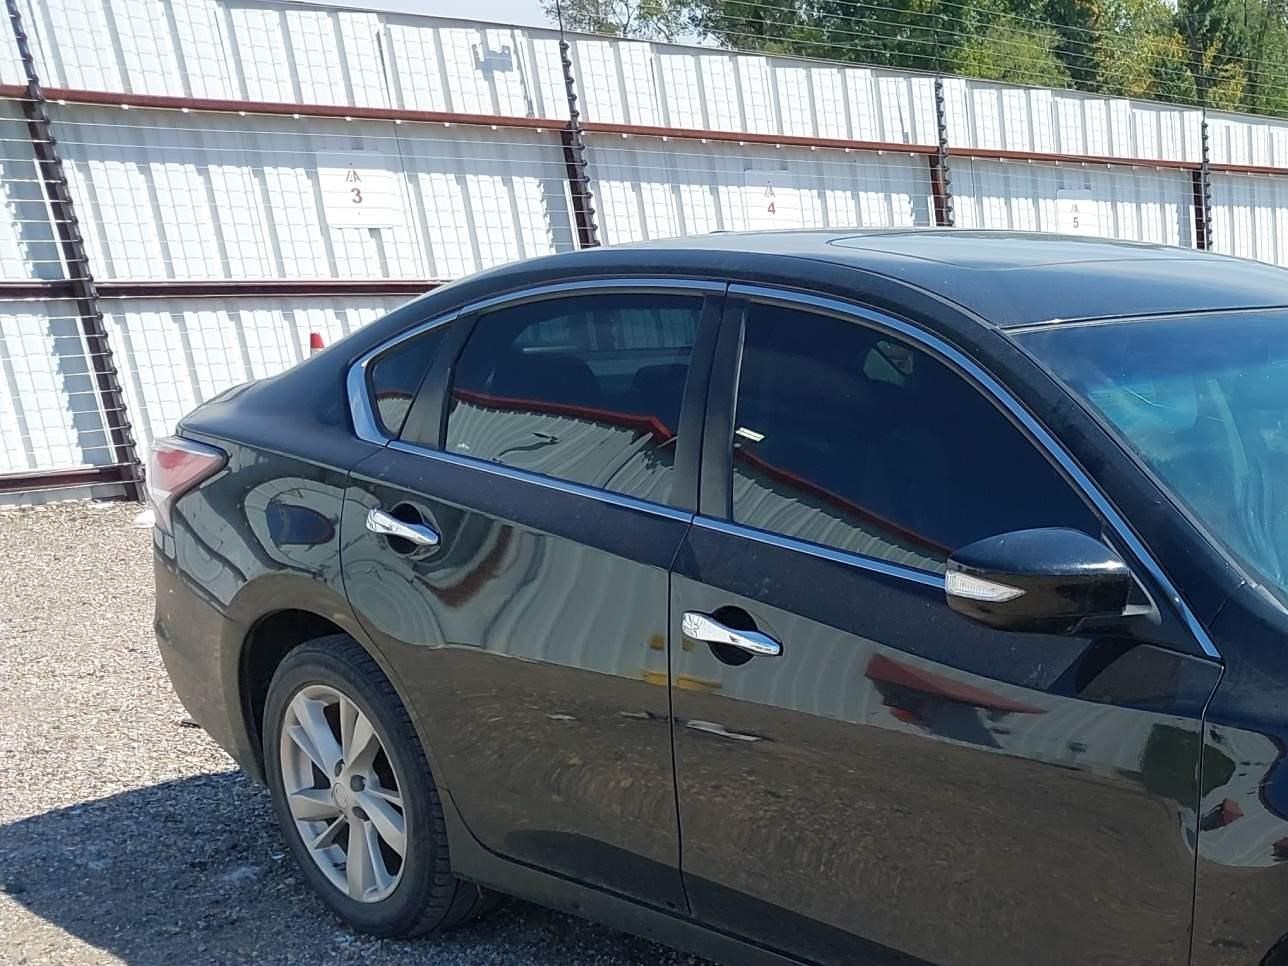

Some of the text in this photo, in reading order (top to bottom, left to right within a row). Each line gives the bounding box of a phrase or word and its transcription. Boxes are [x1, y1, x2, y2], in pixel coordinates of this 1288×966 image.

[351, 187, 363, 204] 3
[767, 201, 776, 215] 4
[1073, 216, 1079, 229] 5
